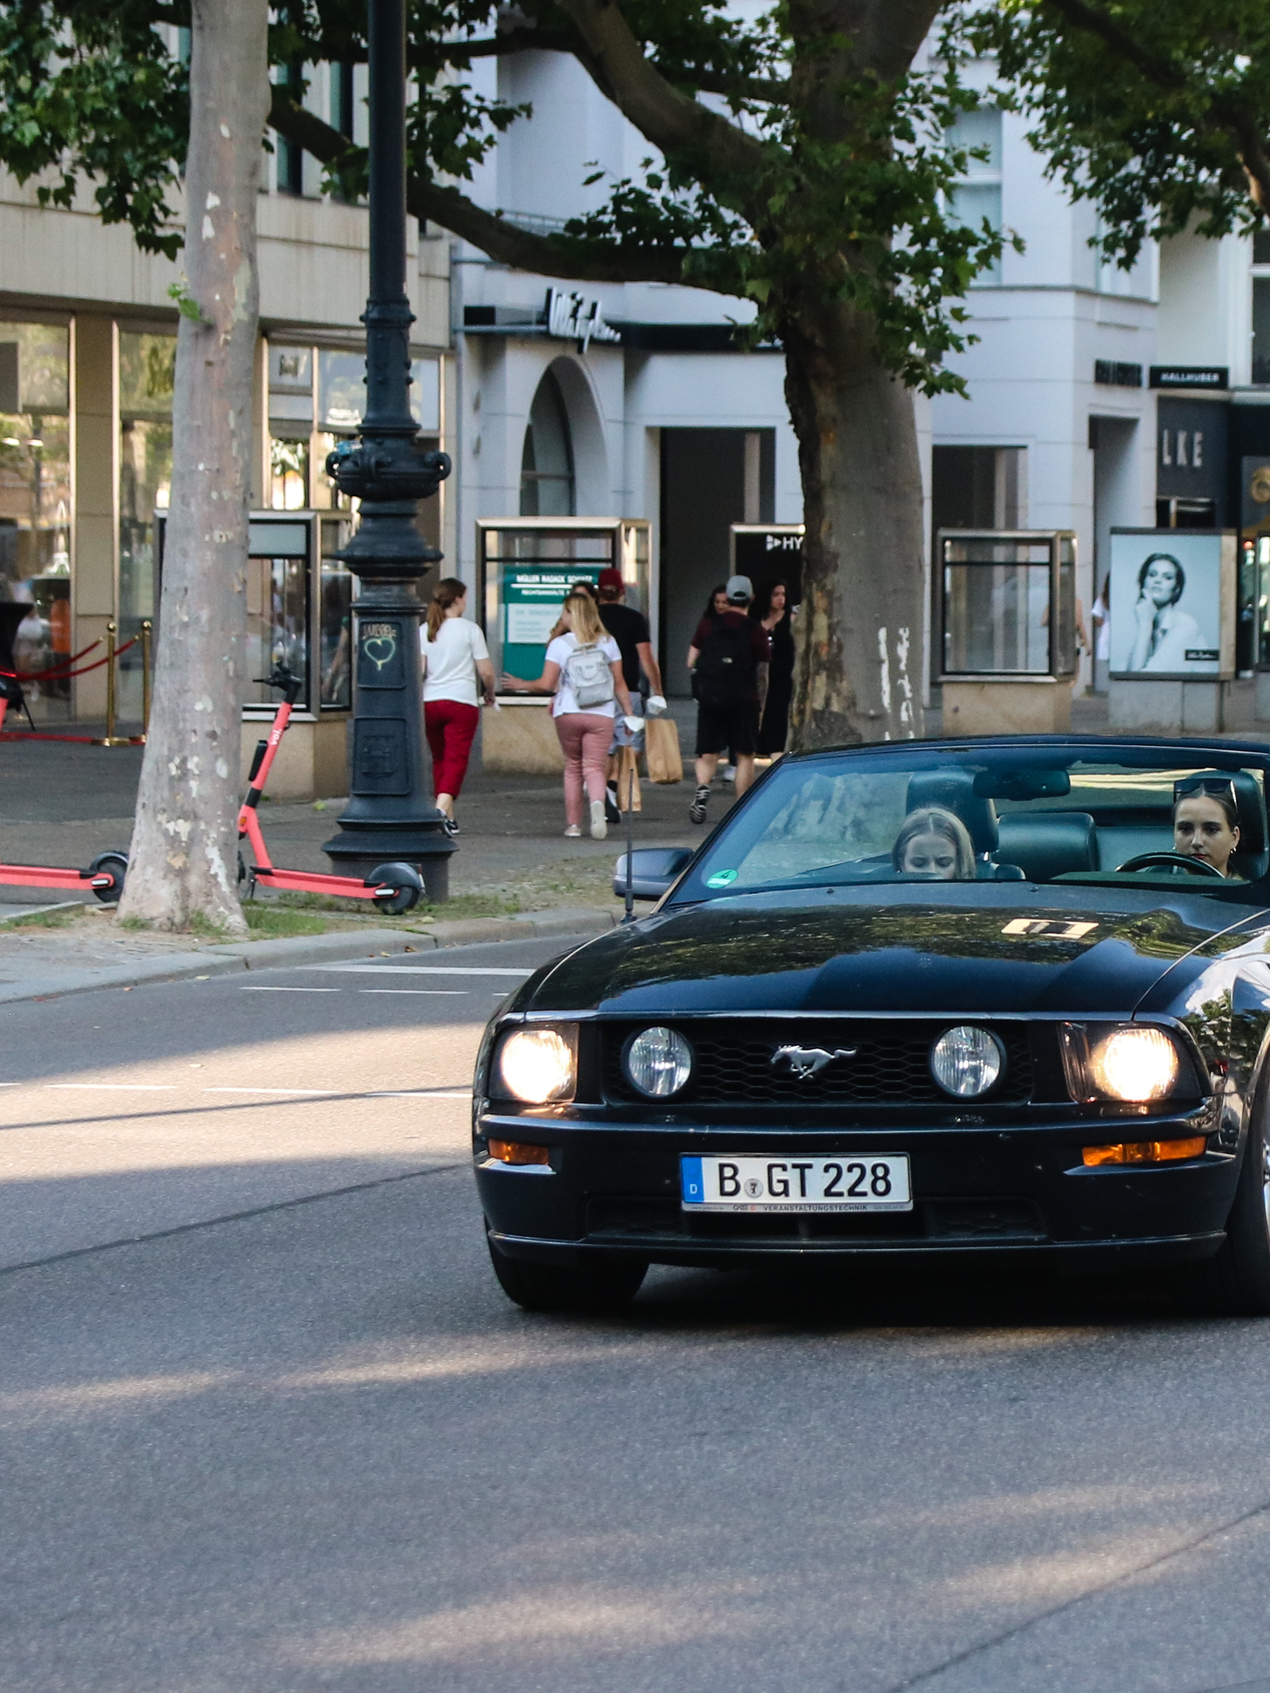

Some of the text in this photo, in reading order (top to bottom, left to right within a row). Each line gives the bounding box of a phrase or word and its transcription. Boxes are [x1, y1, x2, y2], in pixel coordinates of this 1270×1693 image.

[1160, 371, 1220, 383] HALLHUBER
[718, 1162, 892, 1198] B GT 228
[689, 1184, 698, 1194] D
[763, 1203, 868, 1212] VERANSTALTUNGSTECHNIK
